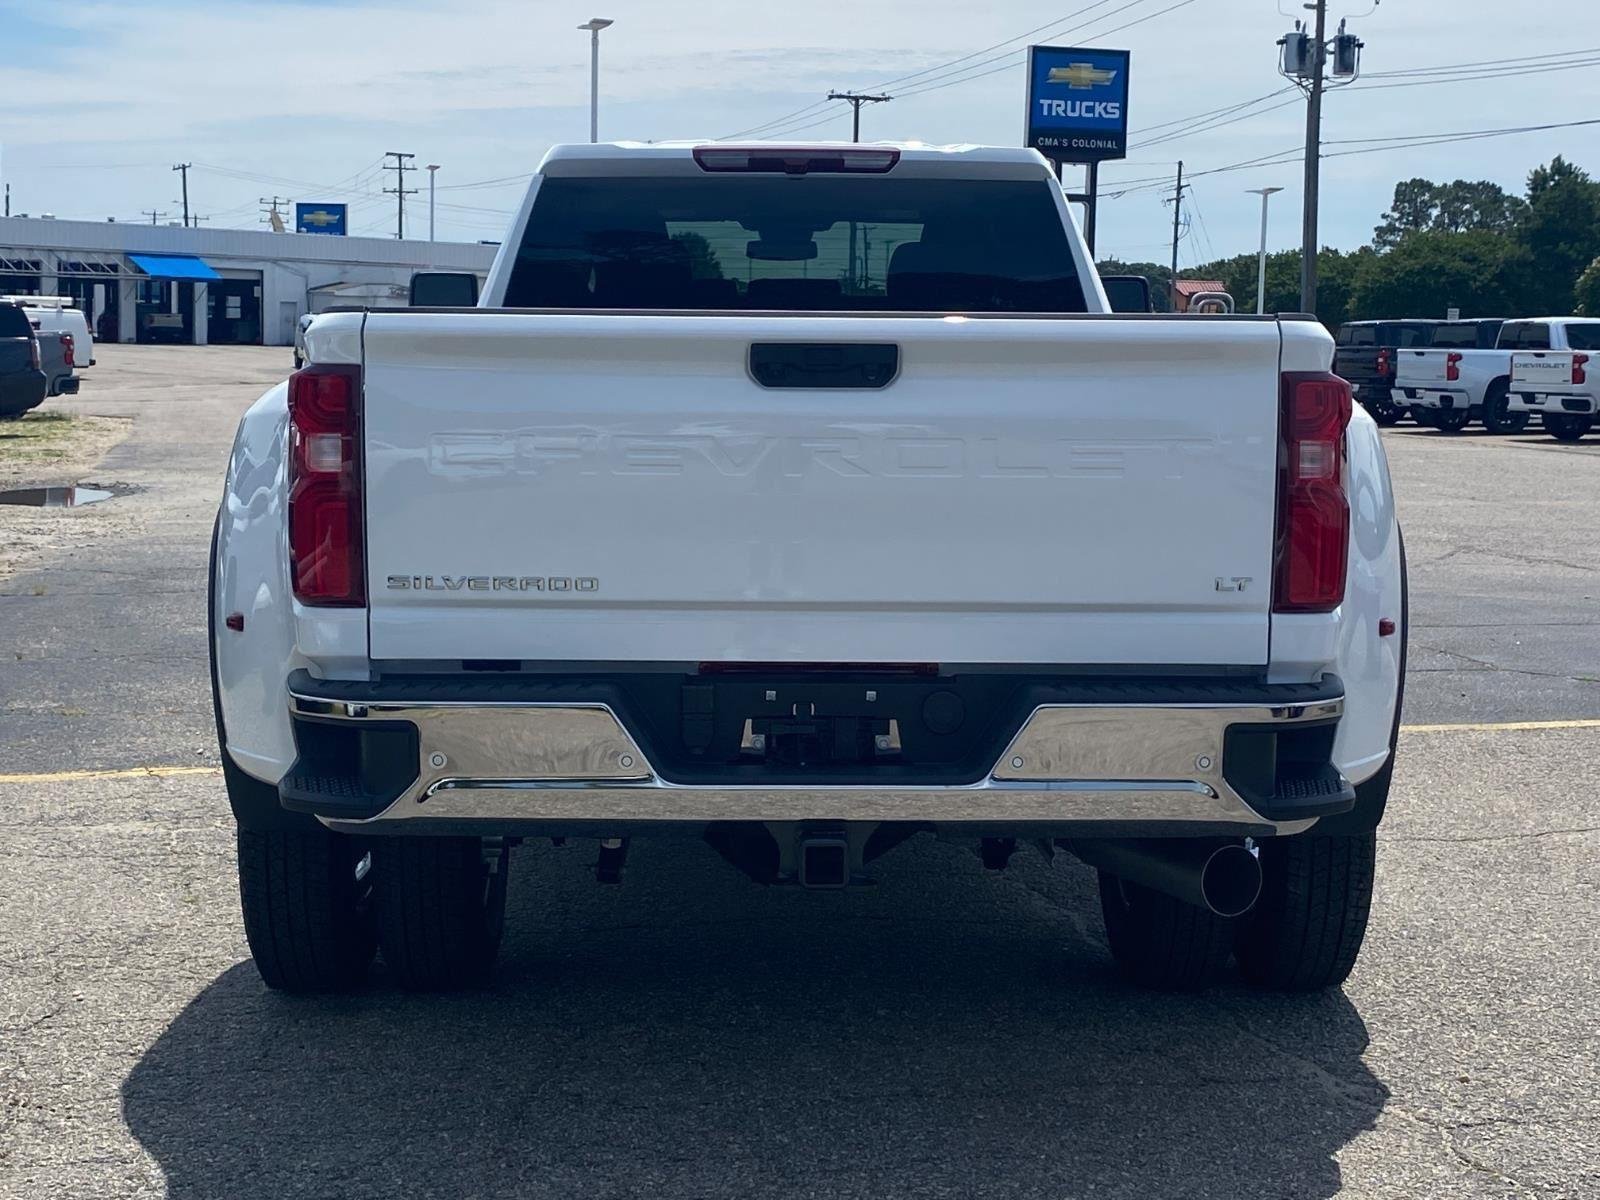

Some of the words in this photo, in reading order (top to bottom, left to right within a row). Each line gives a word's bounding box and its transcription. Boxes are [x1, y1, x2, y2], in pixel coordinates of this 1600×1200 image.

[1039, 99, 1120, 119] TRUCKS
[1037, 136, 1068, 147] CMA'S
[1071, 138, 1118, 149] COLONIAL
[425, 431, 1218, 479] CHEVROLET
[387, 574, 600, 592] SILVERADO
[1214, 576, 1253, 592] LT
